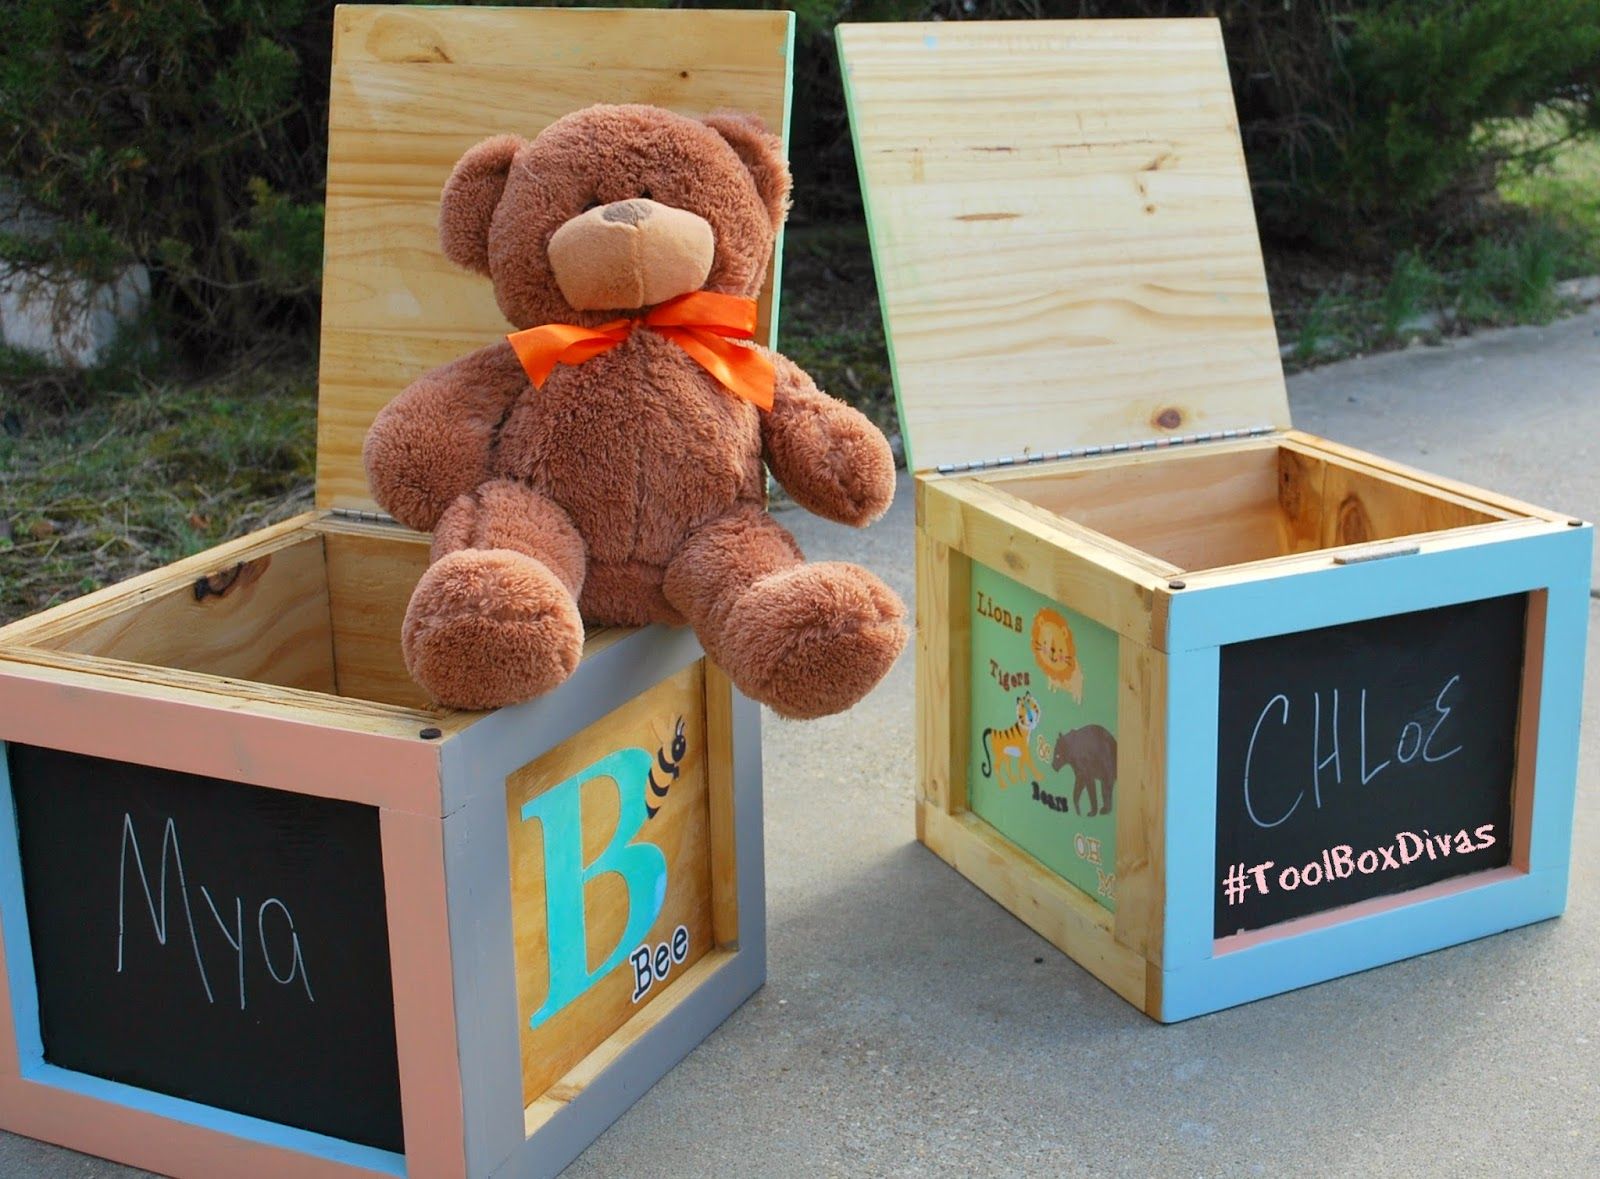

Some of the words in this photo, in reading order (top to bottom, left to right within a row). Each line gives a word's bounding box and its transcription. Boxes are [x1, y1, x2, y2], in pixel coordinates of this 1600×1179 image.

[977, 591, 1023, 633] Lions
[990, 658, 1030, 692] Tigers
[1074, 833, 1101, 865] OH
[117, 812, 315, 1011] Mya
[520, 747, 667, 1031] B
[629, 925, 688, 1003] Bee
